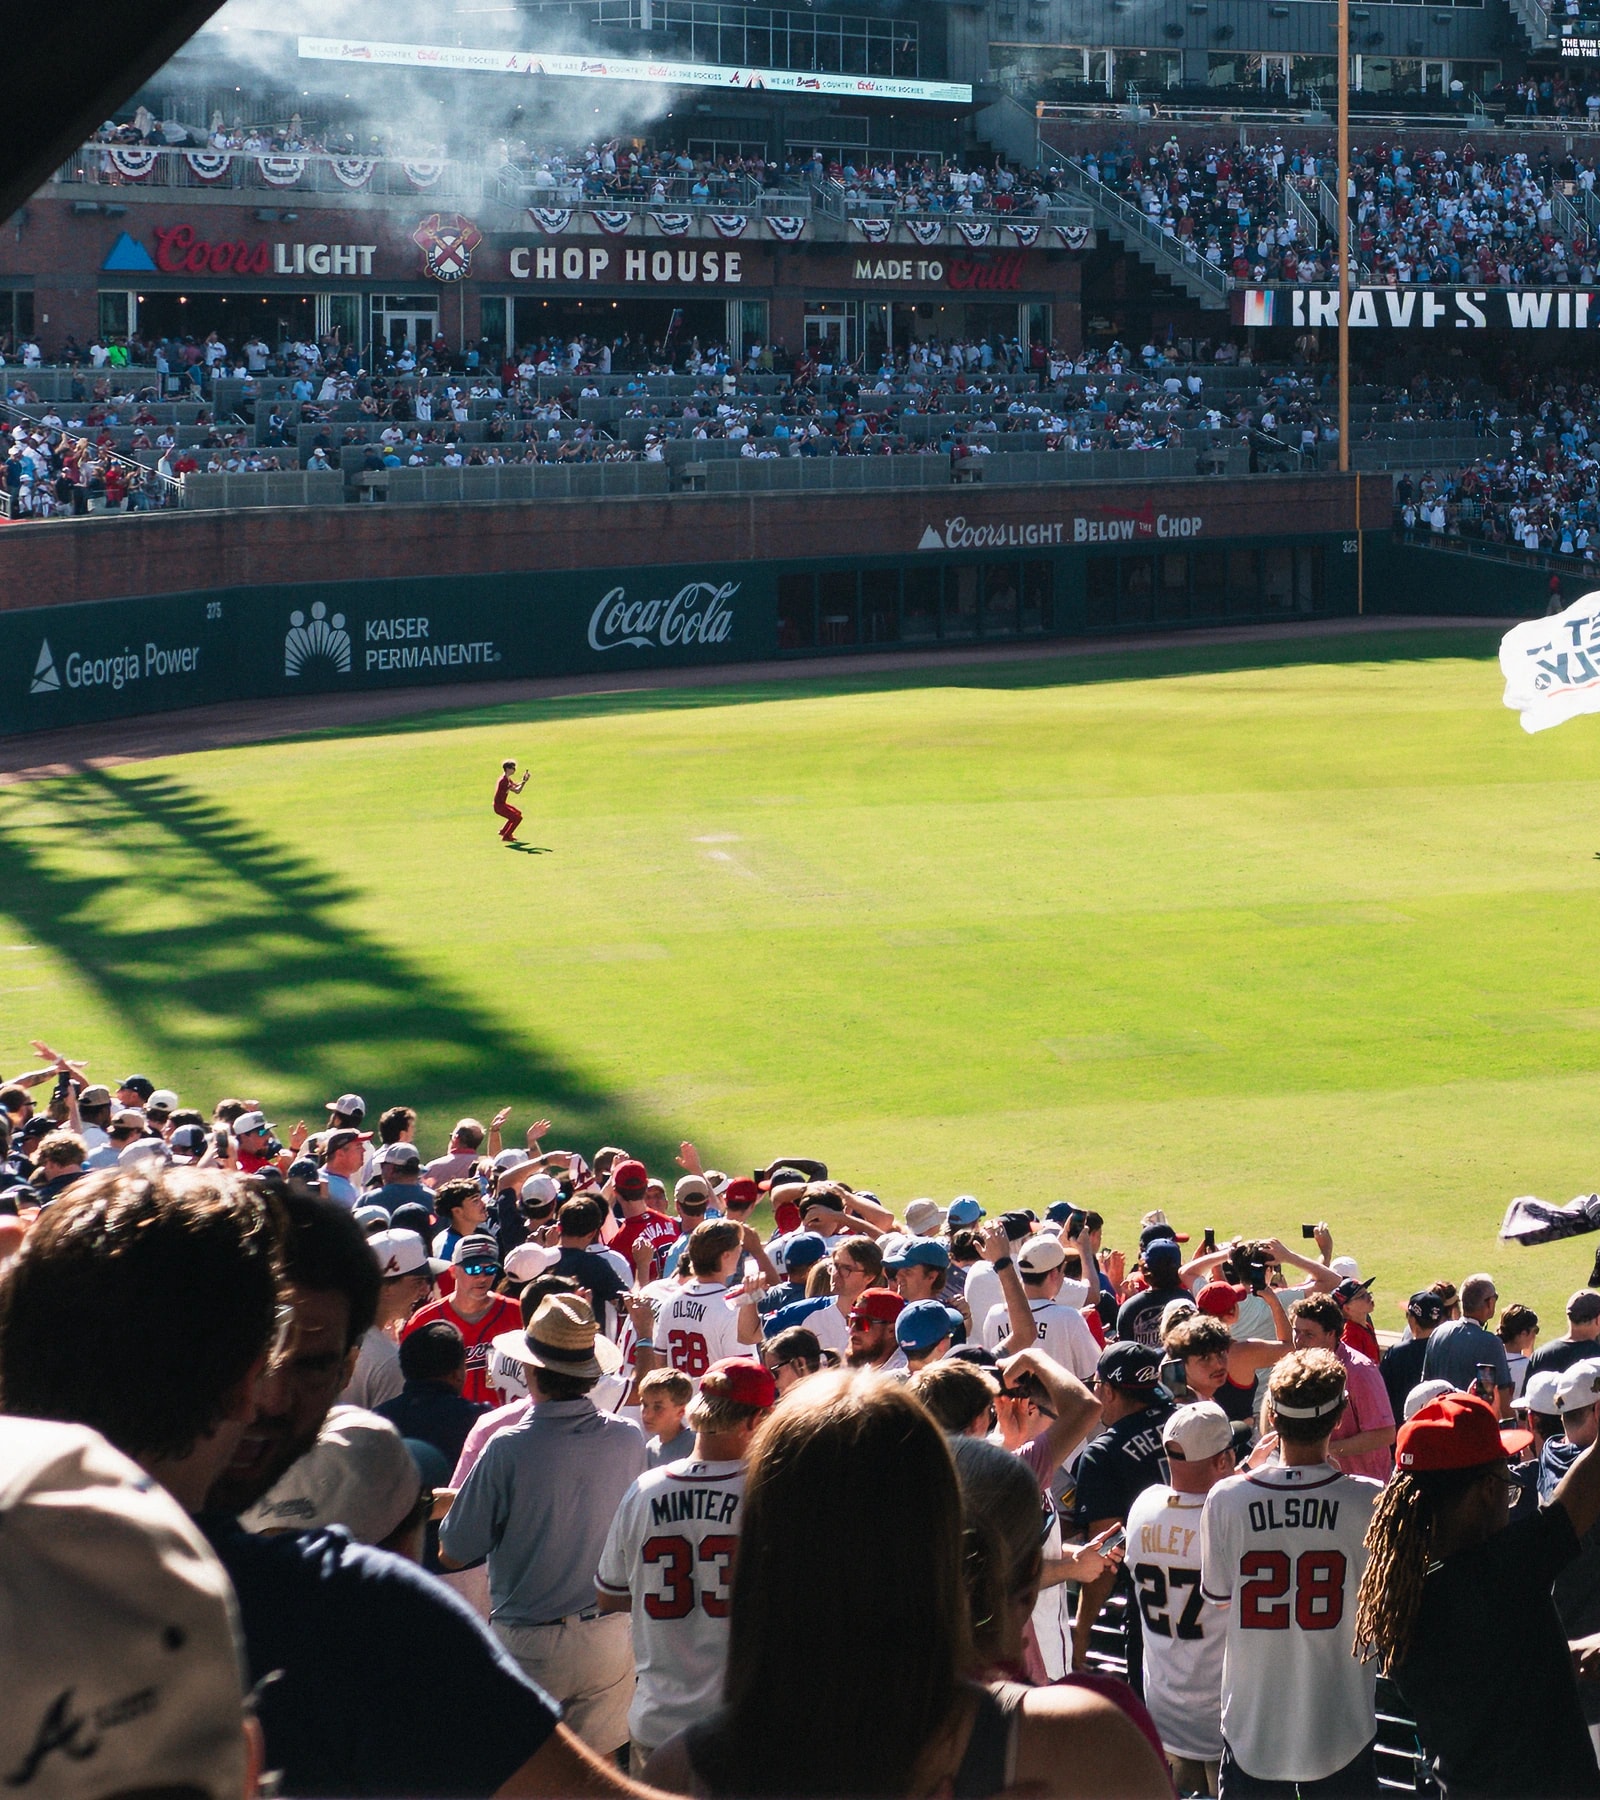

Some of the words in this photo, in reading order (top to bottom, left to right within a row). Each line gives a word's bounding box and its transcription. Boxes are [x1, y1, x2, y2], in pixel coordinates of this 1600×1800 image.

[1561, 38, 1578, 48] THE
[1580, 39, 1596, 48] WIN
[1561, 48, 1579, 57] AND
[1580, 48, 1598, 57] THE
[154, 224, 271, 274] Coors
[273, 243, 377, 275] LIGHT
[510, 247, 609, 280] CHOP
[625, 249, 742, 282] HOUSE
[855, 259, 912, 281] MADE
[917, 260, 943, 281] TO
[946, 516, 1007, 548] Coors
[1008, 522, 1064, 546] LIGHT
[1139, 521, 1152, 533] THE
[1156, 513, 1202, 538] CHOP
[1342, 540, 1358, 553] 325
[206, 602, 222, 620] 375
[588, 582, 742, 651] Coca-Cola
[365, 617, 429, 642] KAISER
[66, 647, 139, 690] Georgia
[145, 644, 200, 677] Power
[365, 641, 494, 671] PERMANENTE
[672, 1300, 707, 1322] OLSON
[668, 1329, 709, 1378] 28
[650, 1489, 740, 1527] MINTER
[1248, 1498, 1340, 1532] OLSON
[1141, 1523, 1197, 1557] RILEY
[642, 1534, 740, 1620] 33
[1240, 1550, 1347, 1631] 28
[1134, 1562, 1205, 1641] 27
